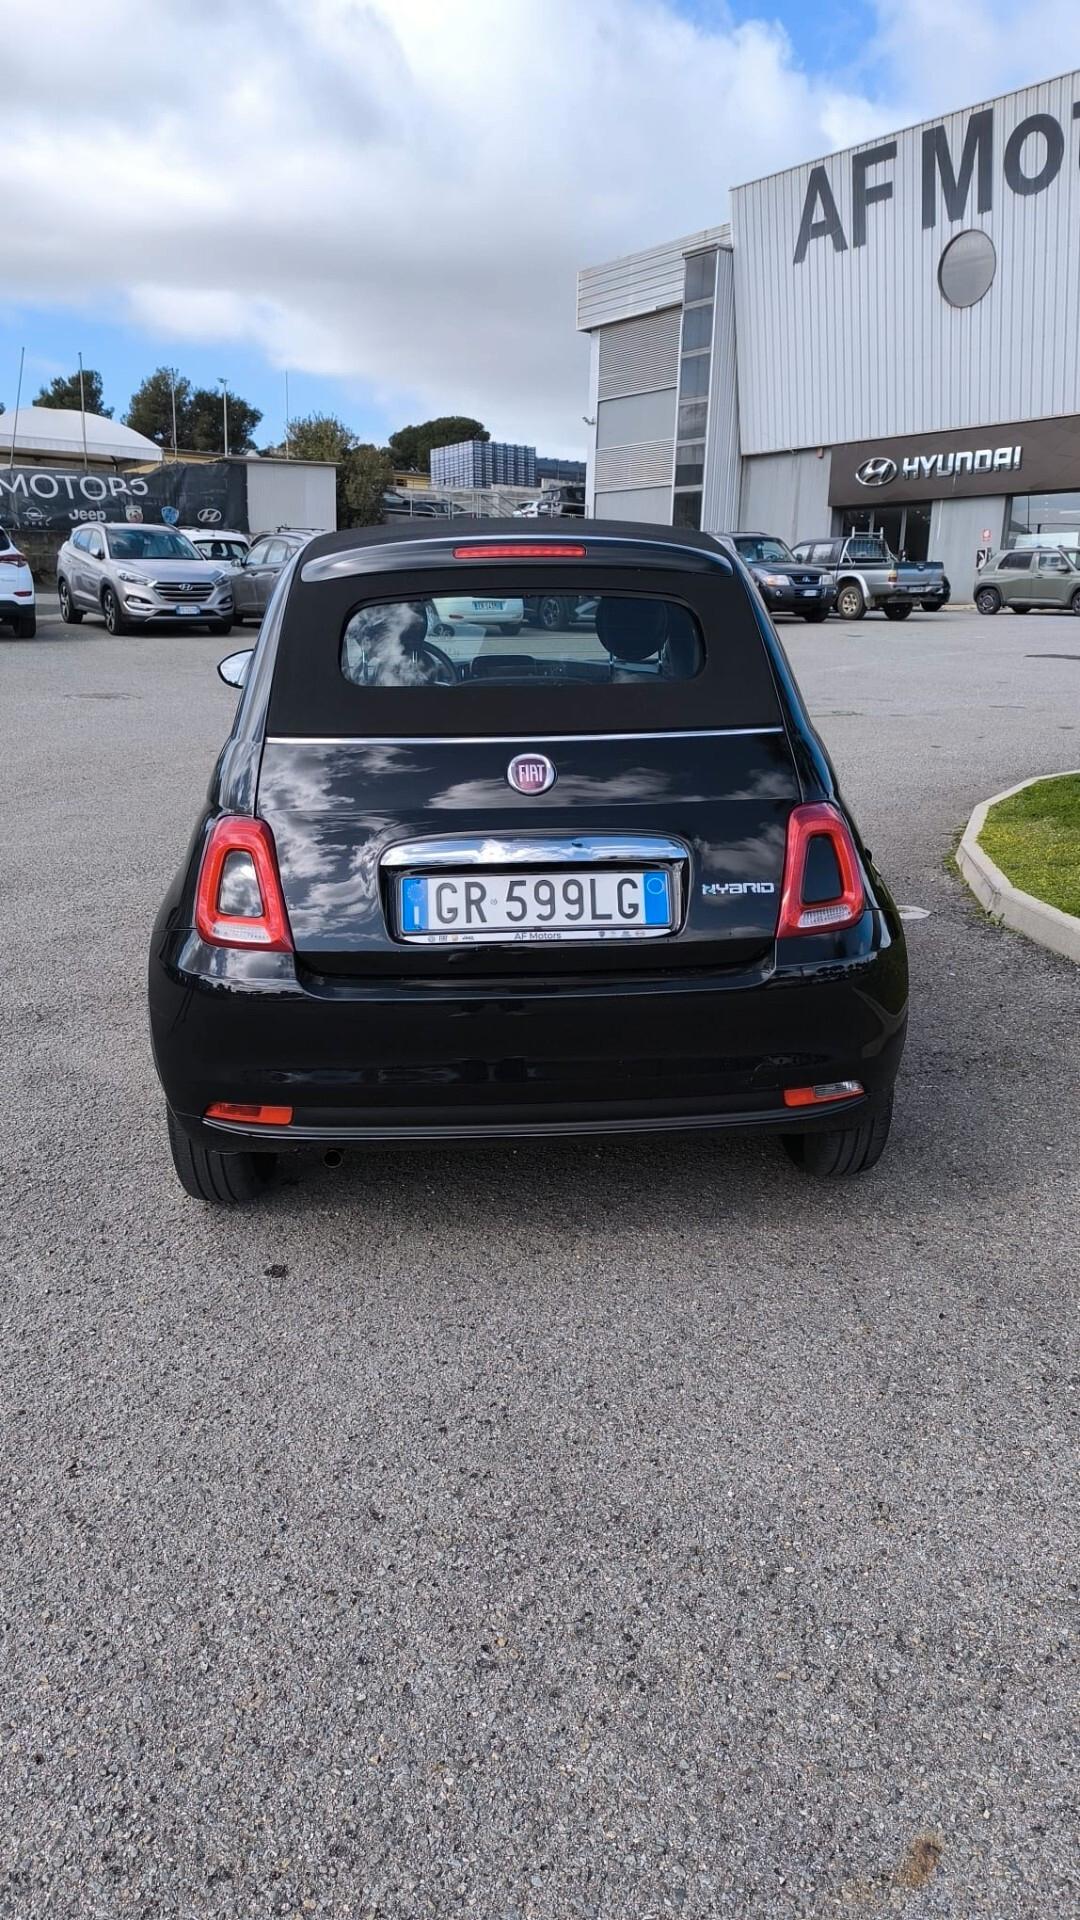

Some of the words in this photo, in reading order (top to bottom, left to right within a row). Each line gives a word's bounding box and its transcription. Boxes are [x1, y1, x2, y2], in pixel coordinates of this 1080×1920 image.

[793, 141, 897, 264] AF
[922, 101, 1080, 230] MO
[902, 446, 1022, 479] HYUNDAI
[0, 473, 149, 501] MOTORS
[69, 509, 106, 521] Jeep
[518, 764, 545, 782] FIAT
[702, 882, 774, 895] HYBRID
[436, 881, 487, 924] GR
[505, 878, 640, 922] 599LG
[513, 932, 528, 941] AF
[529, 931, 562, 940] Motors
